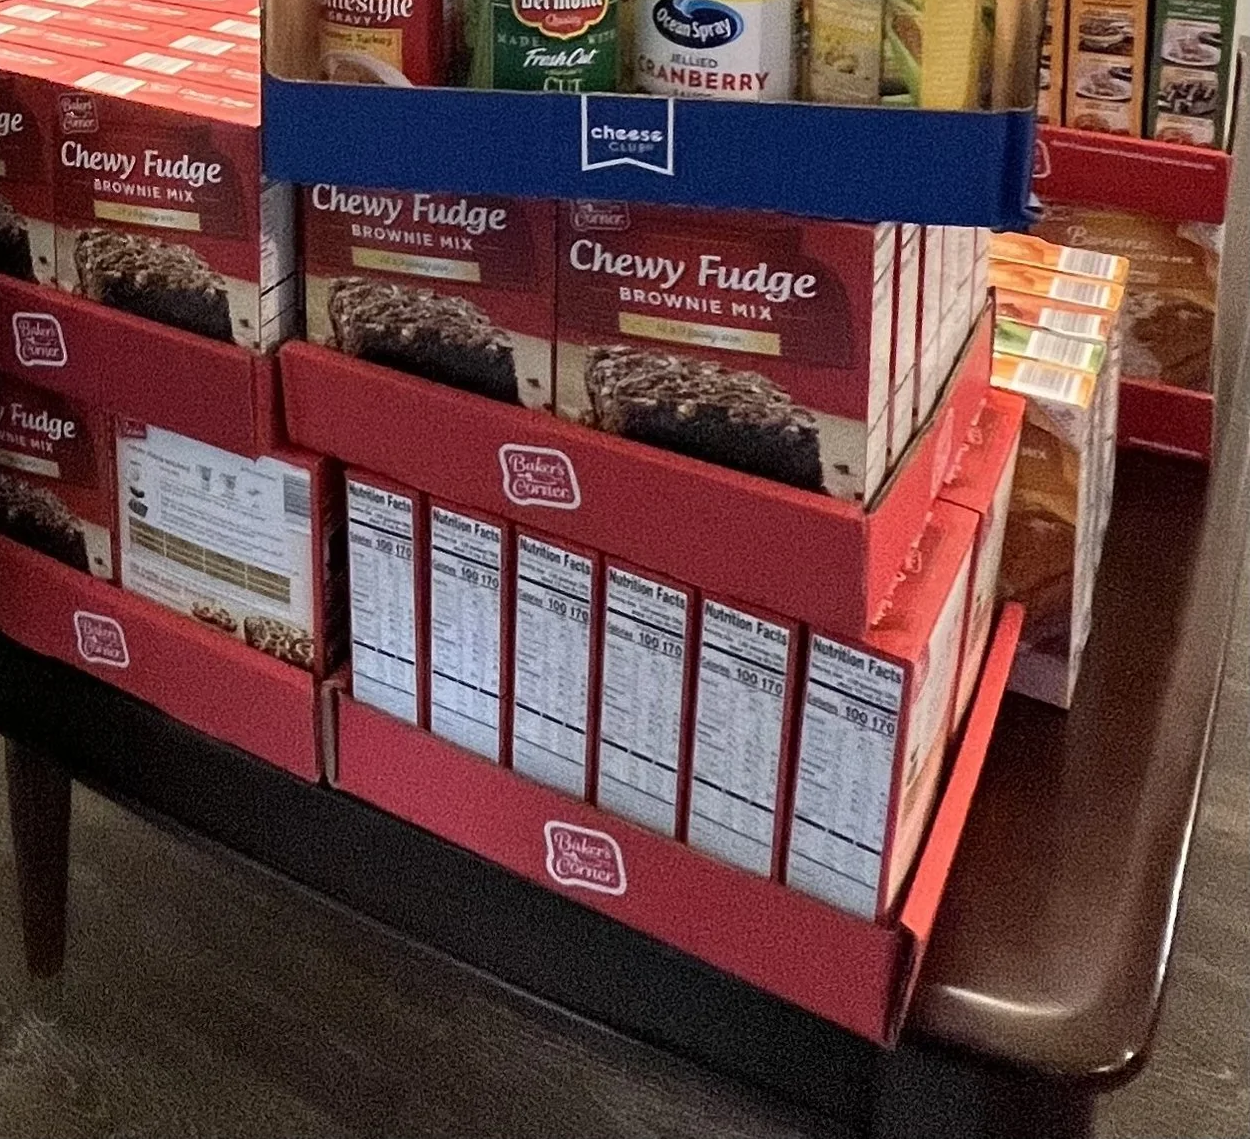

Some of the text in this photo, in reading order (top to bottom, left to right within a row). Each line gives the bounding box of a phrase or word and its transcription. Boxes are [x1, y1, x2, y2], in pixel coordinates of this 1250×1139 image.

[656, 7, 732, 43] Ocean Spray
[523, 47, 600, 68] Fresh Cut
[670, 53, 718, 69] JELLIED
[590, 125, 664, 142] cheese
[61, 140, 222, 188] Chewy Fudge
[93, 178, 195, 203] BROWNIE MIX
[312, 183, 507, 235] Chewy Fudge
[351, 224, 474, 251] BROWNIE MIX
[569, 239, 817, 302] Chewy Fudge
[619, 286, 773, 321] BROWNIE MIX
[11, 402, 76, 440] Fudge
[508, 453, 565, 476] Baker's
[512, 478, 569, 498] Corner
[387, 494, 411, 512] Facts
[433, 510, 500, 543] Nutrition Facts
[520, 538, 591, 576] Nutrition Facts
[481, 574, 499, 589] 170
[609, 569, 686, 609] Nutrition Facts
[548, 598, 567, 615] 100
[570, 606, 588, 622] 170
[705, 603, 787, 646] Nutrition Facts
[639, 632, 683, 657] 100 170
[813, 637, 902, 684] Nutrition Facts
[736, 667, 758, 686] 100
[761, 677, 784, 695] 170
[845, 706, 895, 735] 100 170
[556, 857, 616, 882] Corner
